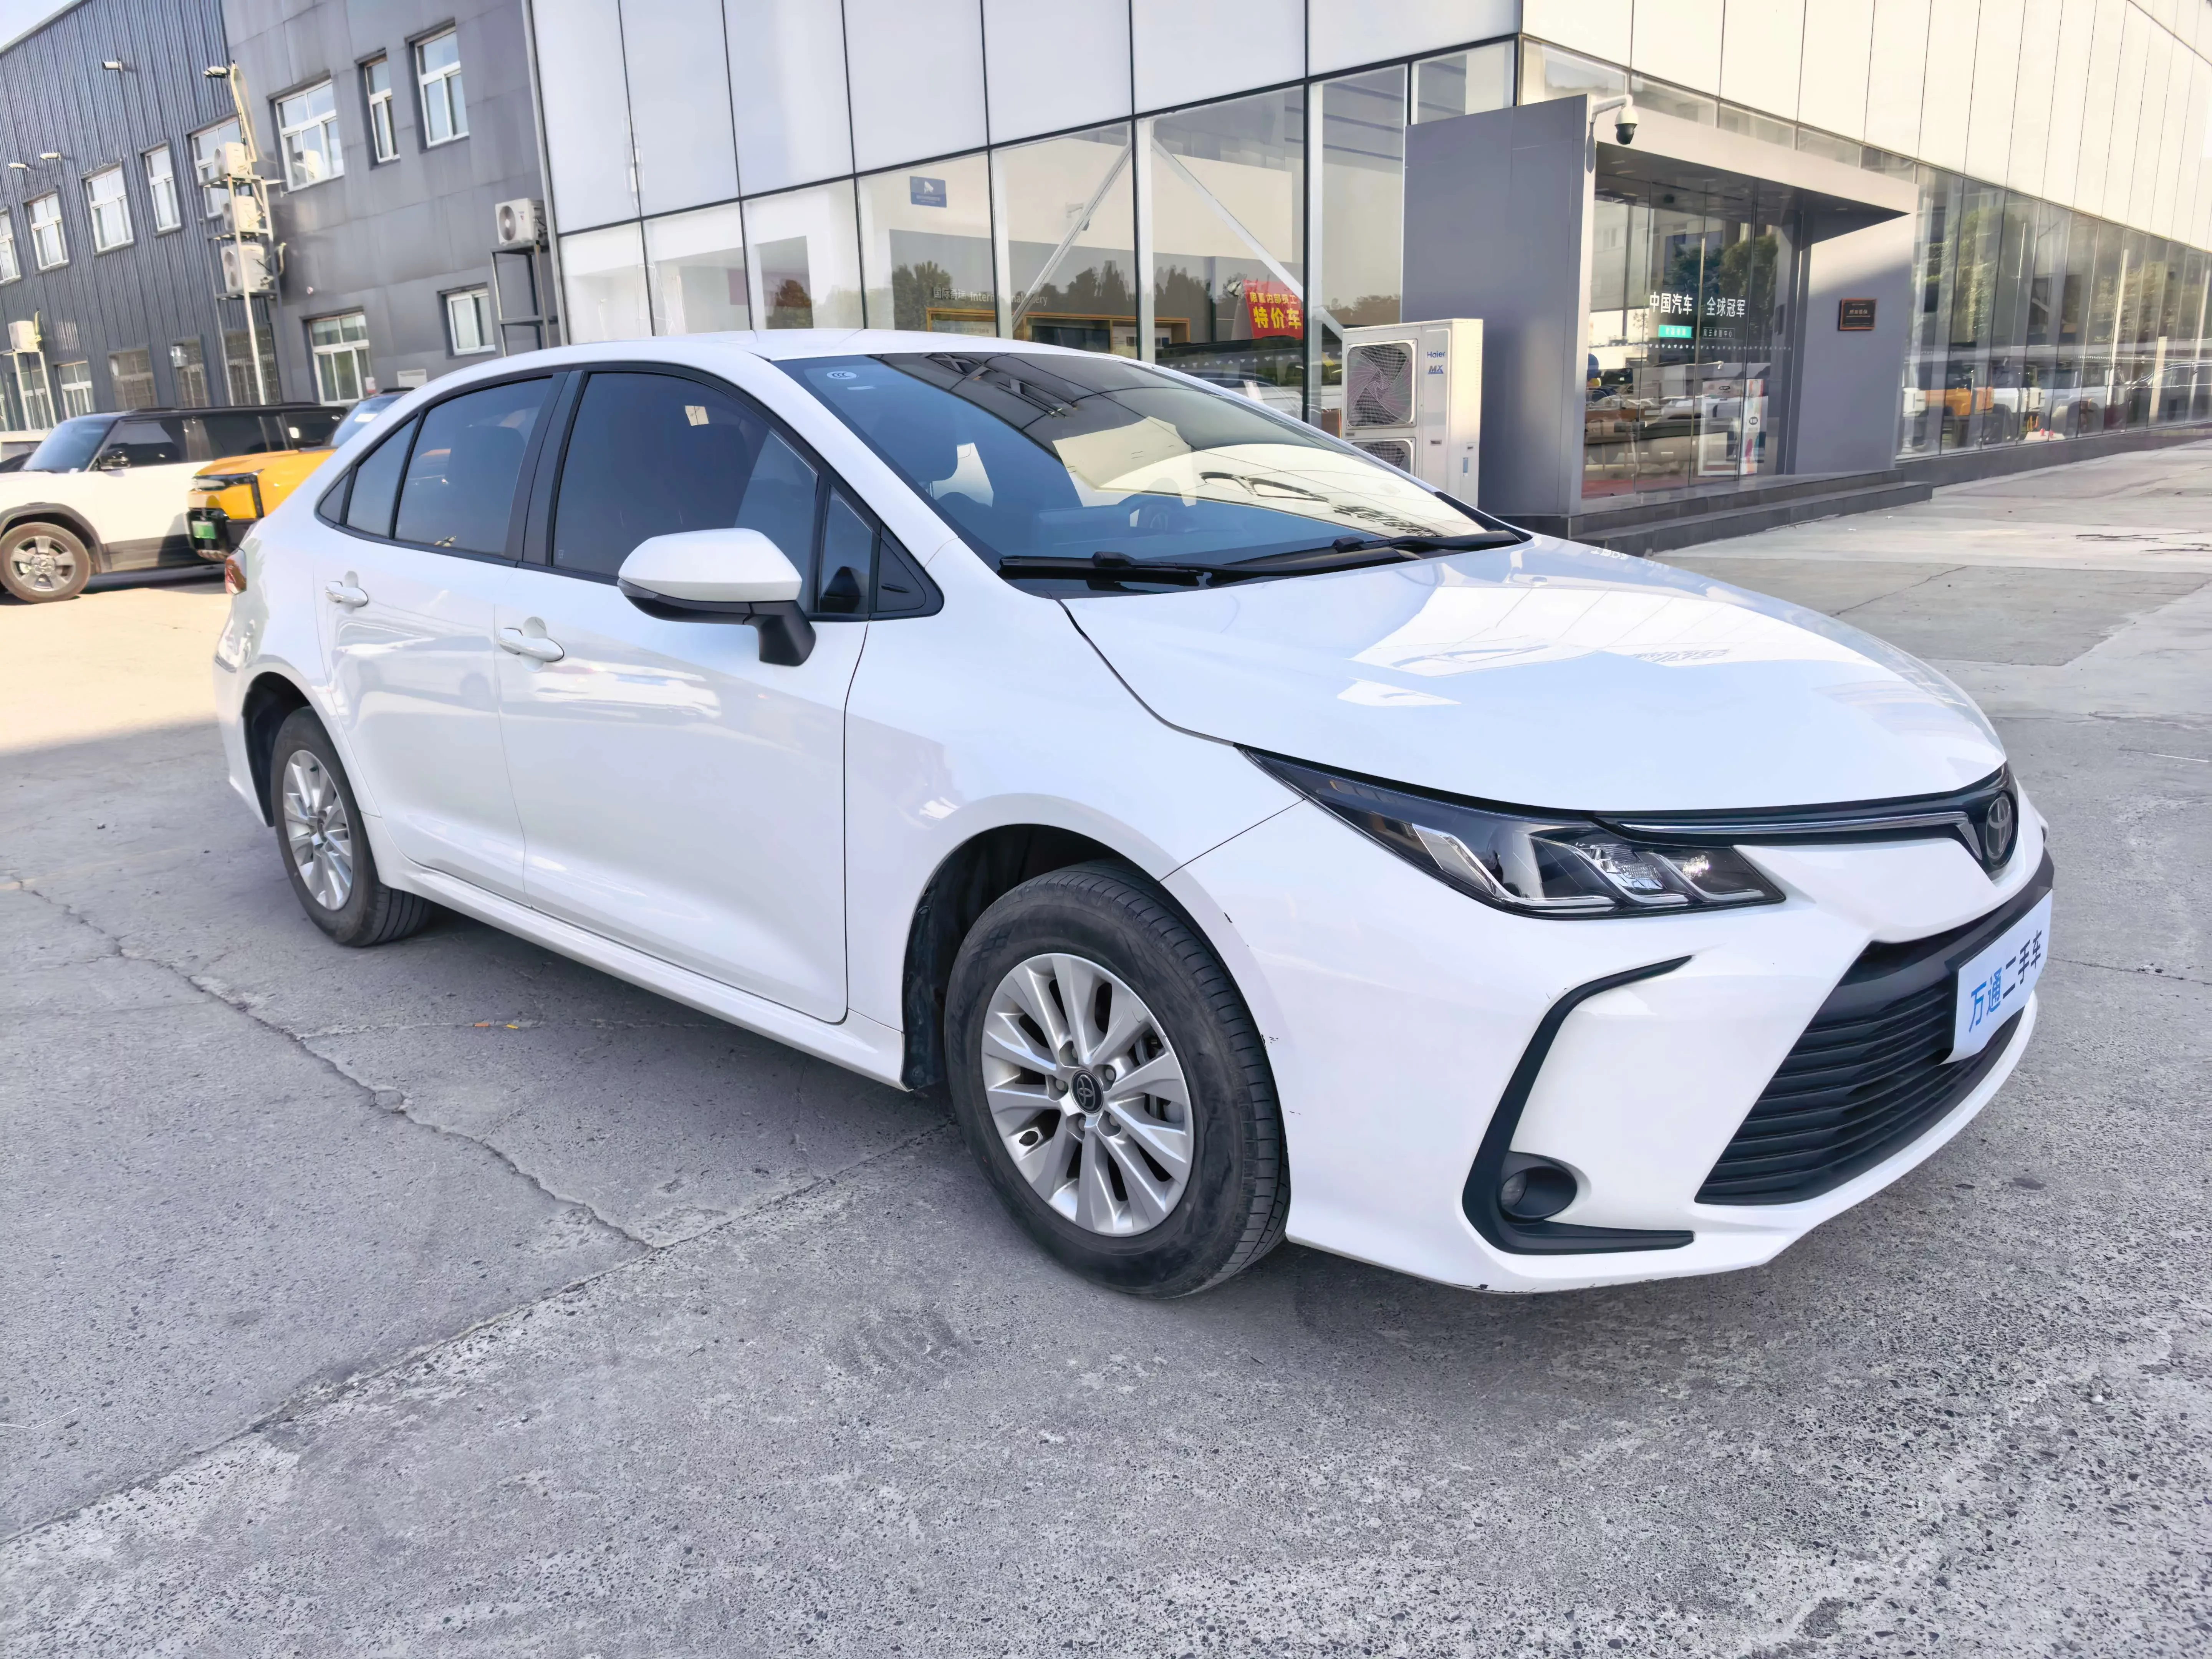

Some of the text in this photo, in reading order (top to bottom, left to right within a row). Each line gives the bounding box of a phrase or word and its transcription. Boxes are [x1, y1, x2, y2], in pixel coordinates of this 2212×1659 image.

[1649, 291, 1745, 318] 中国汽车 全球冠军
[1253, 306, 1302, 329] 特价车
[1428, 364, 1444, 374] MX
[1969, 930, 2042, 1033] 万通二手车
